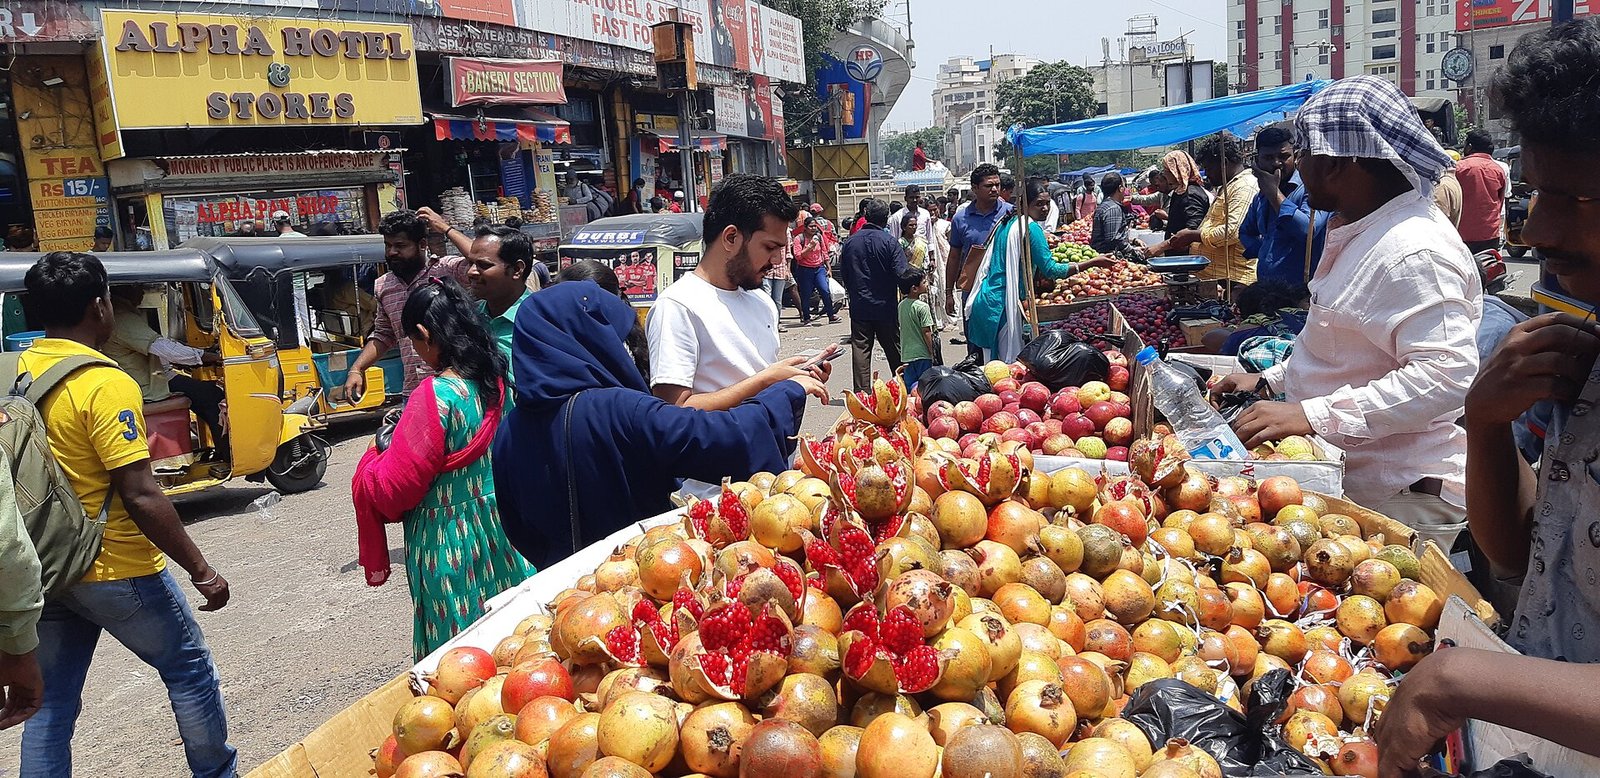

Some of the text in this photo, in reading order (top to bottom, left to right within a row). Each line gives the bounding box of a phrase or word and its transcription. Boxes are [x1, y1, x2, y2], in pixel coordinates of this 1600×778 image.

[645, 2, 654, 21] &
[484, 29, 504, 41] TEA
[592, 14, 654, 44] FAST FO
[116, 20, 412, 60] ALPHA HOTEL
[596, 44, 613, 57] TEA
[855, 50, 874, 60] HP
[1147, 45, 1160, 54] SAI
[633, 53, 650, 64] SELF
[268, 61, 291, 87] &
[629, 62, 656, 74] SERVICE
[467, 70, 557, 93] BAKERY SECTION
[207, 91, 356, 119] STORES
[40, 156, 97, 175] TEA
[210, 159, 221, 173] AT
[224, 157, 255, 172] PUBLIC
[257, 156, 284, 172] PLACE
[286, 157, 294, 170] IS
[67, 179, 99, 195] 15/-
[36, 198, 64, 208] MUTTON
[197, 200, 253, 223] ALPHA
[296, 195, 339, 216] SHOP
[38, 210, 64, 219] CHICKEN
[65, 208, 89, 217] BIRYANI
[40, 220, 54, 228] VEG
[56, 218, 84, 227] BIRYANI
[40, 228, 84, 238] EGG BIRYANI
[576, 231, 639, 241] DURBI
[44, 242, 80, 251] Vehicles
[118, 409, 138, 441] 3
